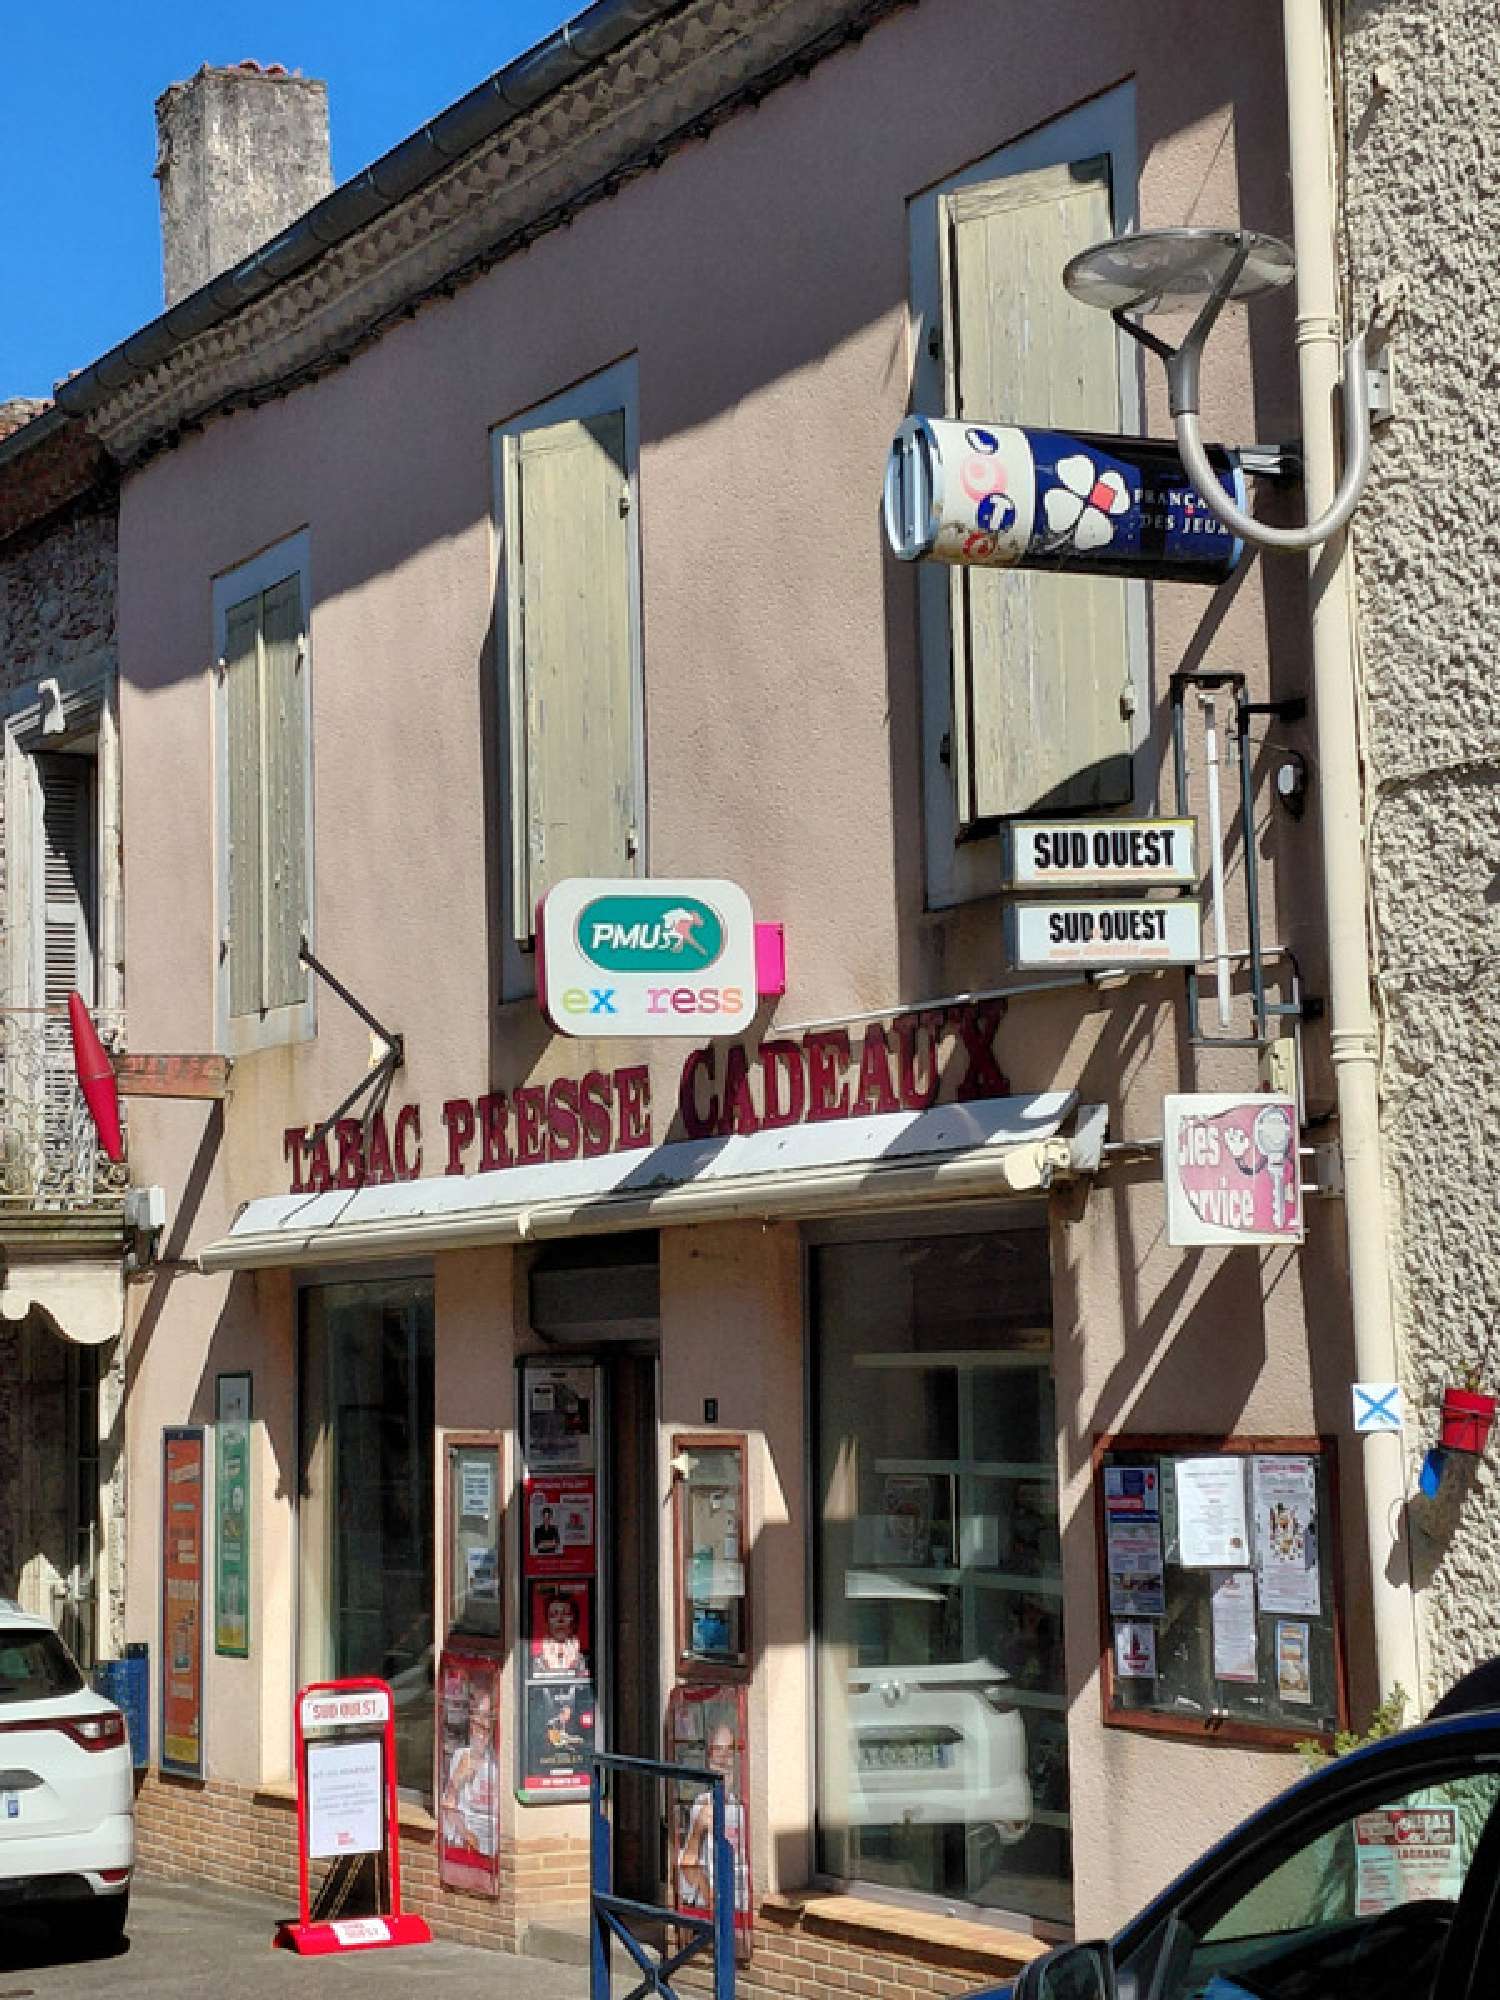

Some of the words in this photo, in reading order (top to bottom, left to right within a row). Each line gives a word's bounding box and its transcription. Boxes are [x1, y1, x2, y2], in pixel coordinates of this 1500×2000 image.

[1033, 831, 1088, 868] SUD
[1093, 830, 1175, 867] OUEST
[592, 922, 660, 950] PMU
[1049, 912, 1094, 943] SUD
[1099, 910, 1168, 942] OUEST
[562, 987, 744, 1014] exress
[284, 1104, 423, 1194] TABAC
[442, 1065, 653, 1176] PRESSE
[679, 998, 1011, 1140] CADEAUX
